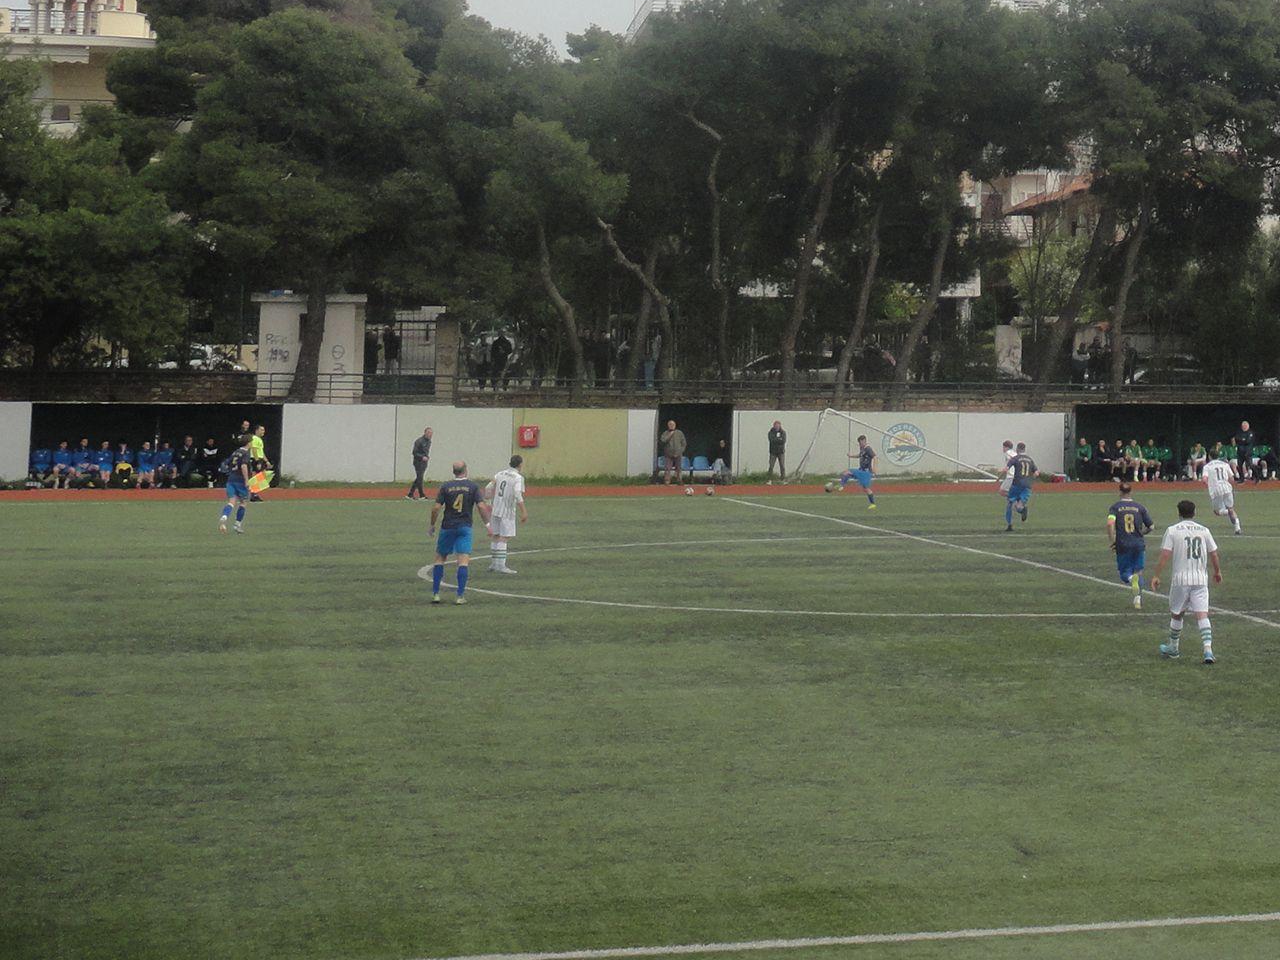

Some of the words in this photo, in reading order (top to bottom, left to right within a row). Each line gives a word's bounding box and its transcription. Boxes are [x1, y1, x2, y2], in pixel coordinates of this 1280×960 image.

[1021, 461, 1030, 476] 11
[1214, 467, 1225, 481] 11
[498, 480, 507, 497] 9
[453, 493, 464, 513] 4
[1124, 513, 1135, 534] 8
[1184, 536, 1203, 560] 10
